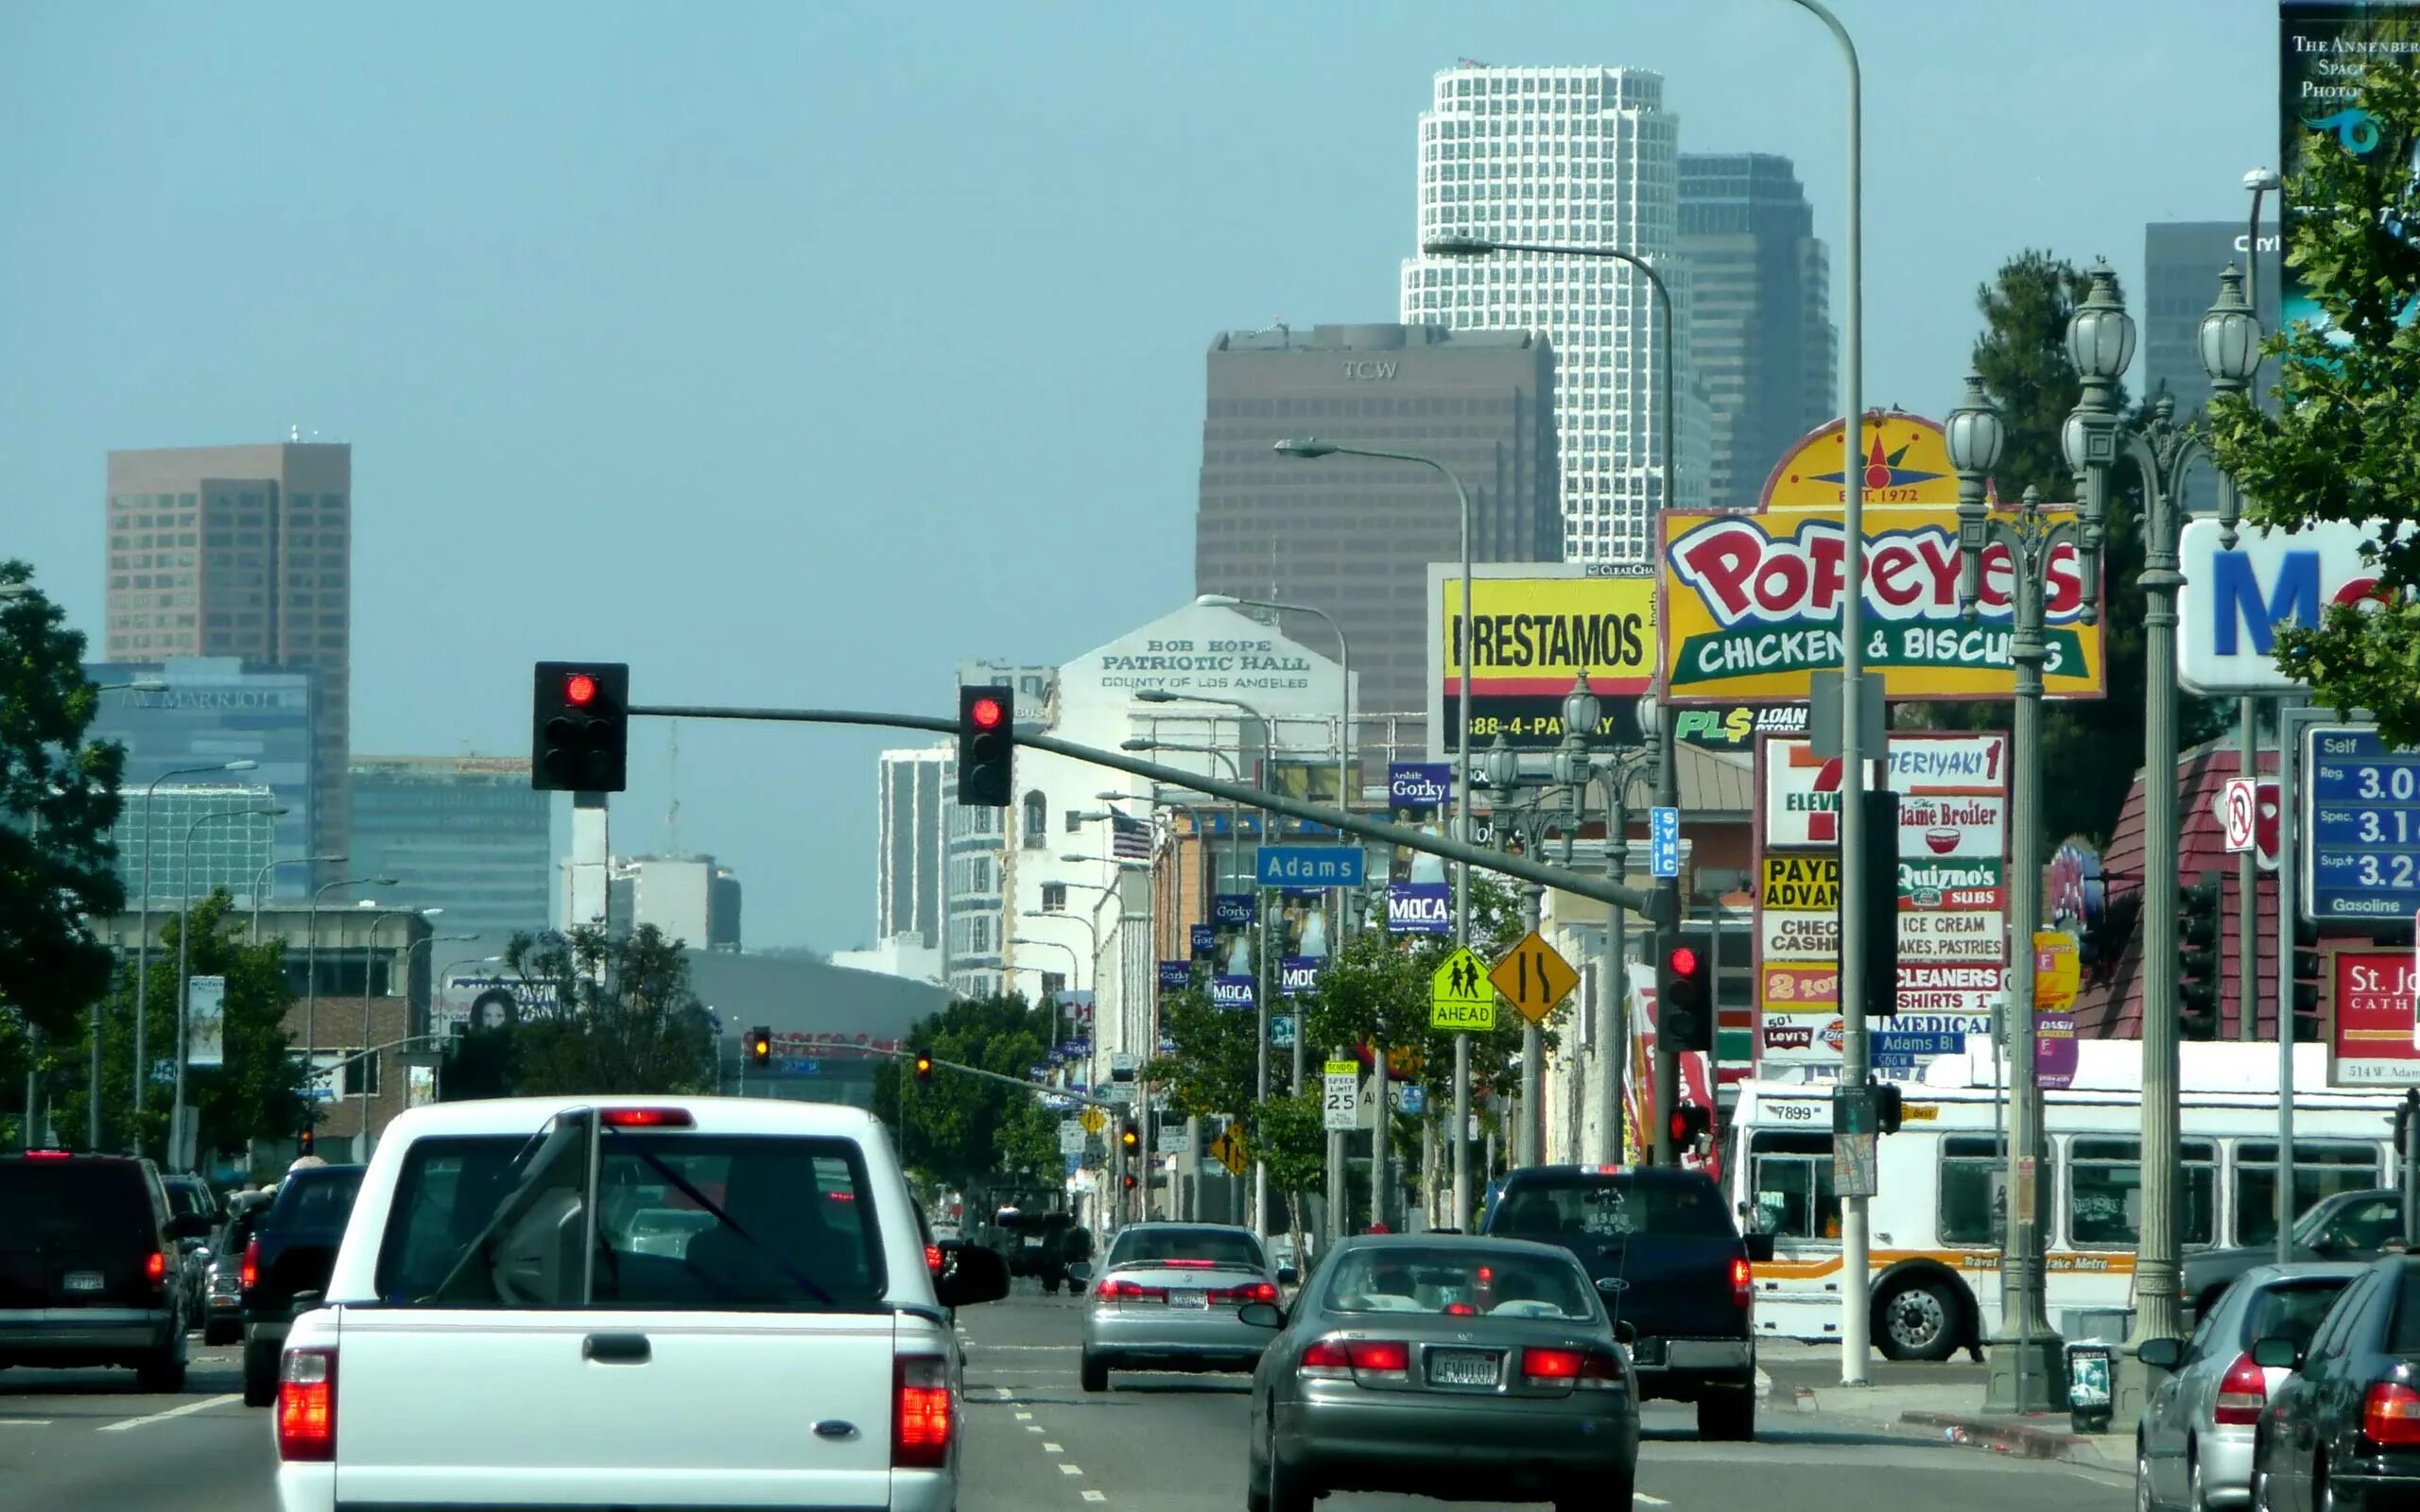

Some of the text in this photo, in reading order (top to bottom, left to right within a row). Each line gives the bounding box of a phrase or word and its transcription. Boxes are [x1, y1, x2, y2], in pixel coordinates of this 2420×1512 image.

[2331, 36, 2420, 53] ANNENBER
[1344, 360, 1397, 378] TCW
[1839, 489, 1918, 503] ET. 1972
[1148, 640, 1271, 652] BOB HOPE
[1453, 614, 1643, 667] PRESTAMOS
[1699, 626, 2063, 673] CHICKEN & BISCUS
[1102, 656, 1310, 671] PATRIOTIC HALL
[1101, 677, 1307, 688] COUNTY OF LOS ANGELES
[1757, 708, 1807, 724] LOAN
[2325, 738, 2358, 753] Self
[1888, 751, 1982, 777] TERIYAKI
[1392, 781, 1445, 800] Gorky
[2360, 767, 2420, 799] 3.0
[1900, 799, 1996, 825] lame Broiler
[2322, 811, 2420, 843] Spec. 3.1
[1268, 856, 1352, 877] Adams
[2360, 855, 2420, 887] 3.2
[1898, 863, 1996, 889] Quizno's
[1217, 905, 1253, 920] Gorky
[1390, 898, 1447, 920] MOCA
[2333, 898, 2400, 913] Gasoline
[1903, 917, 1985, 933] ICE CREAM
[1769, 973, 1795, 999] 2
[1896, 969, 1998, 988] CLEANERS
[2350, 965, 2387, 991] St.
[1213, 984, 1253, 1001] MOCA
[1897, 993, 1963, 1008] SHIRTS
[2350, 998, 2411, 1010] CATH
[1437, 1007, 1490, 1022] AHEAD
[1768, 1015, 1792, 1029] 501
[1883, 1036, 1932, 1051] Adams
[1327, 1063, 1356, 1072] SCHOOL
[2349, 1066, 2371, 1077] 514
[1327, 1094, 1355, 1110] 25
[1777, 1106, 1811, 1120] 7899
[2074, 1257, 2108, 1269] Metro
